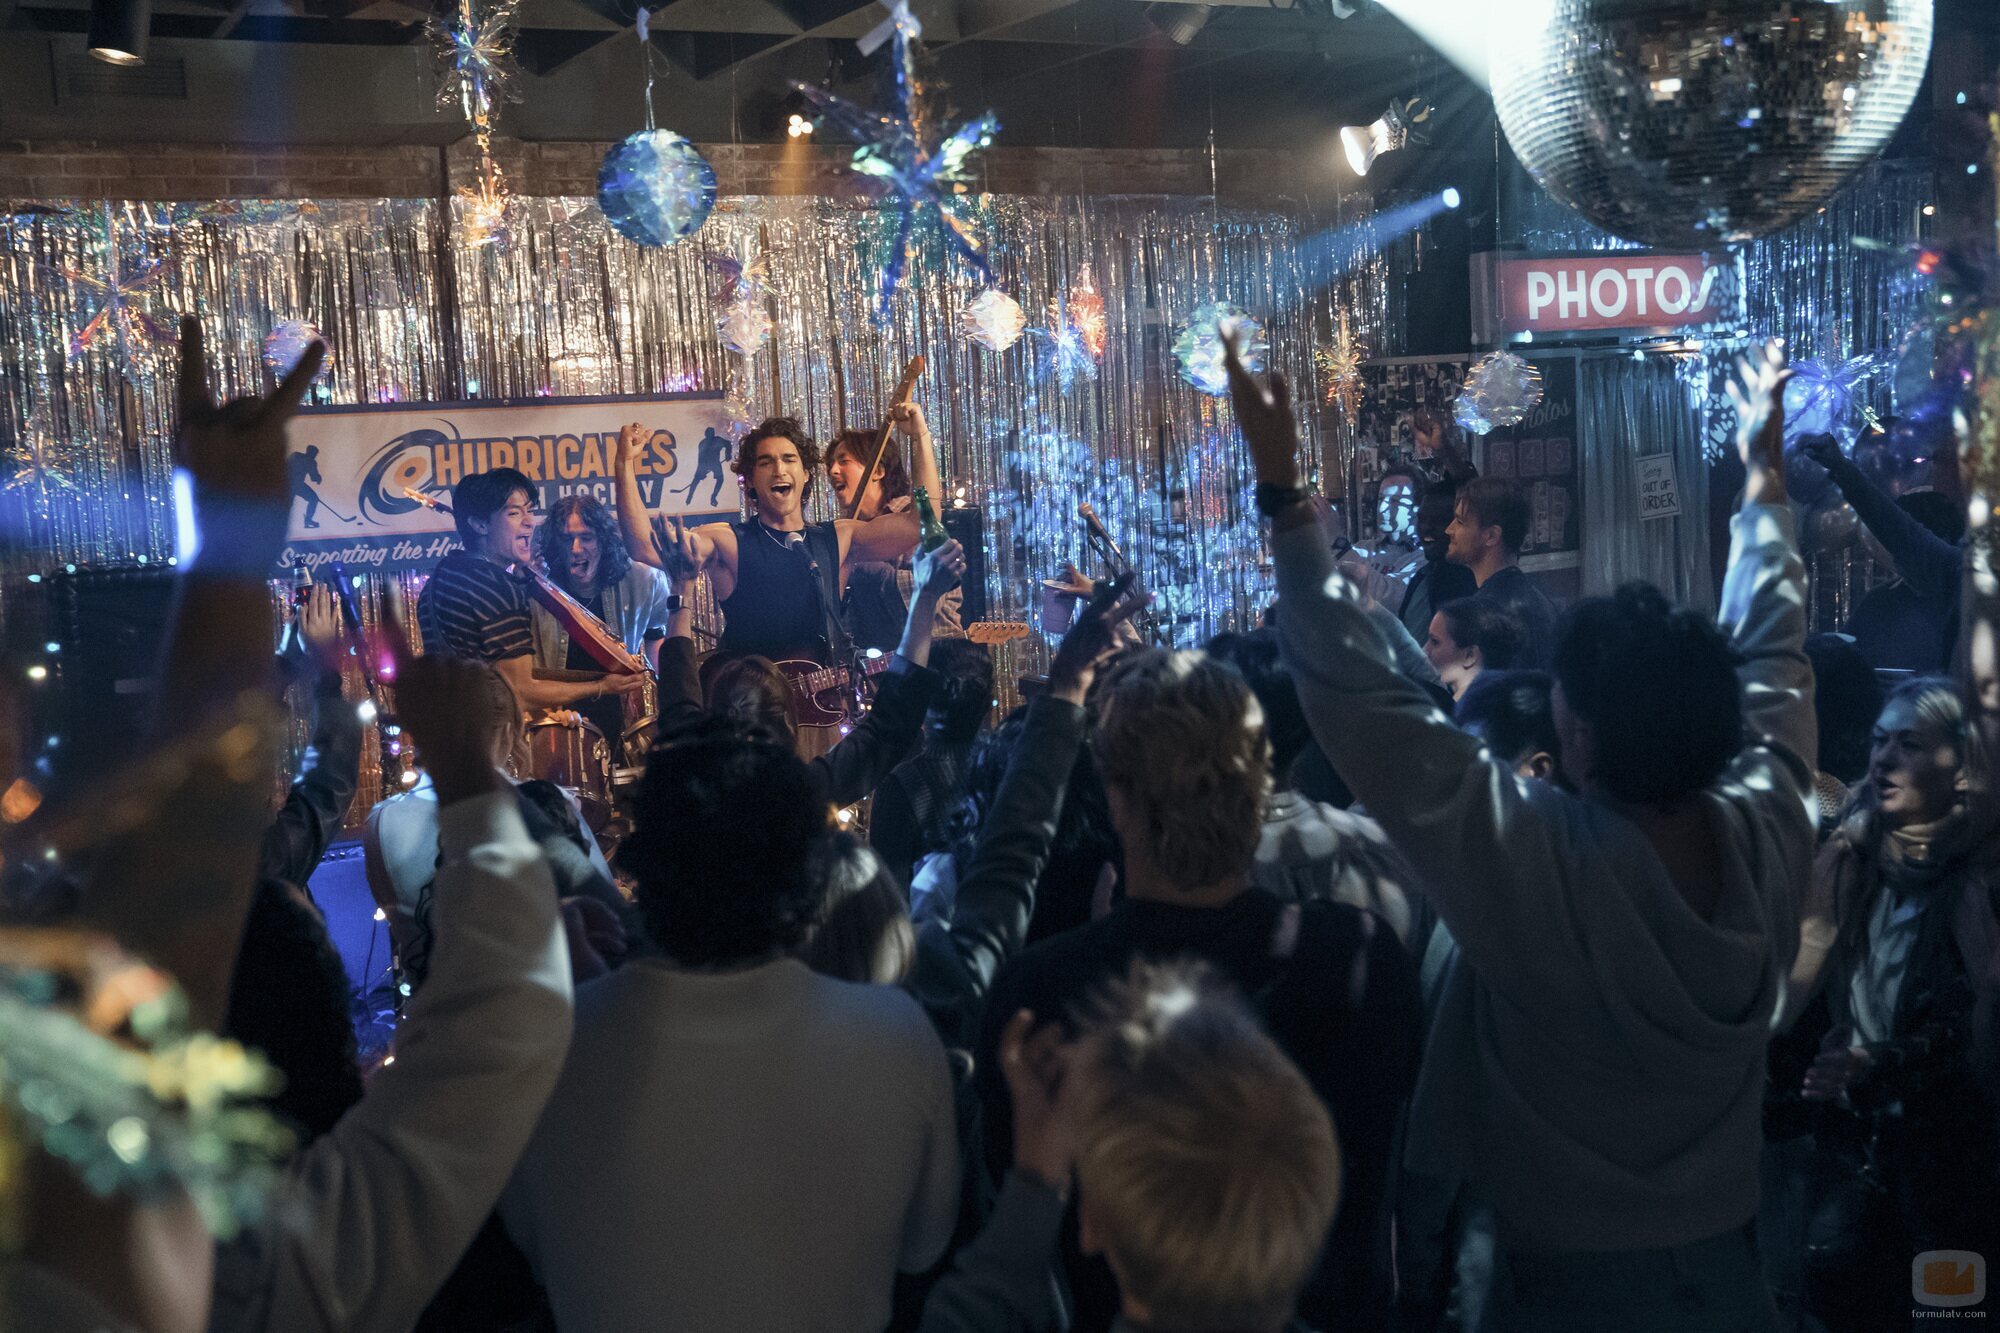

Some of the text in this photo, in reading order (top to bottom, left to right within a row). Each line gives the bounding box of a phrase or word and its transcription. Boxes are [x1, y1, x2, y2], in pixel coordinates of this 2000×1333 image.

[1526, 265, 1719, 321] PHOTOS
[1642, 479, 1671, 493] OUT OF
[1642, 492, 1676, 511] ORDER
[392, 539, 424, 561] the
